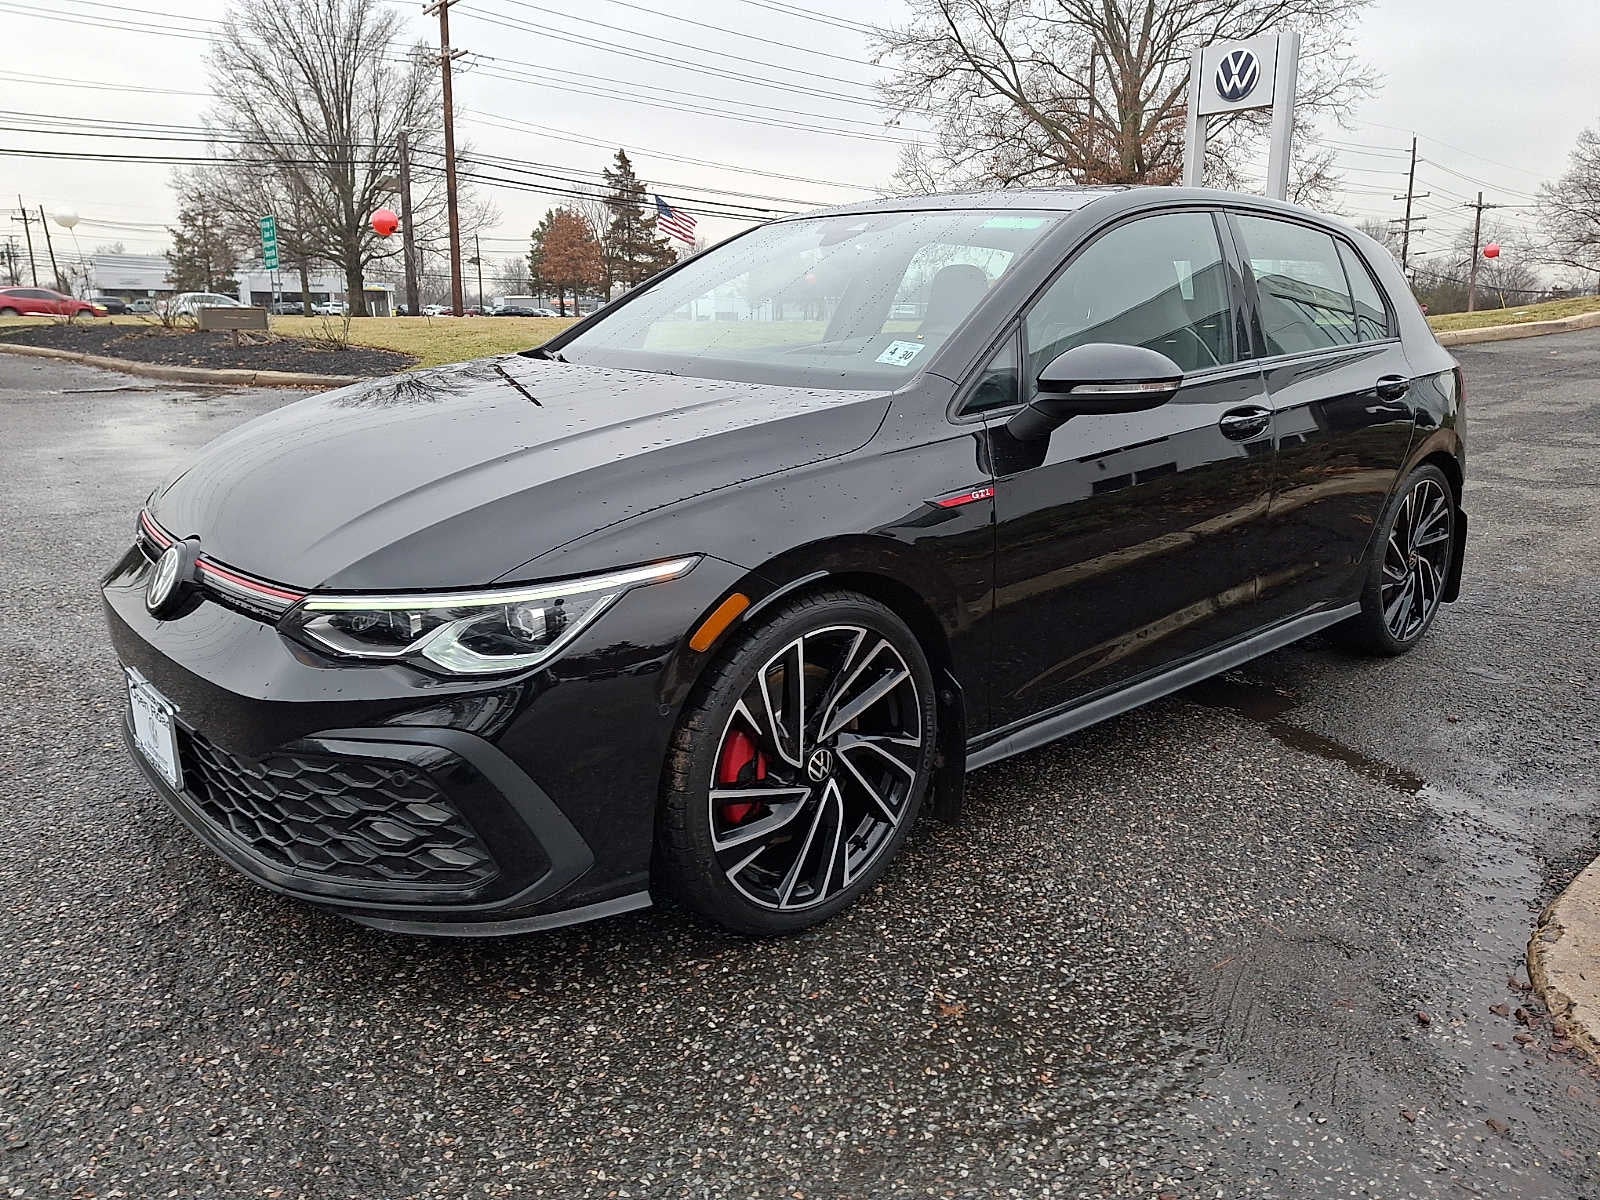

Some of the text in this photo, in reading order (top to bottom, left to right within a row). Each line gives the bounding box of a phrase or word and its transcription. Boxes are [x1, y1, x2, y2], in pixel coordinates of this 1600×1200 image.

[1216, 49, 1259, 101] VW
[971, 488, 991, 499] GTI
[809, 749, 832, 781] VW
